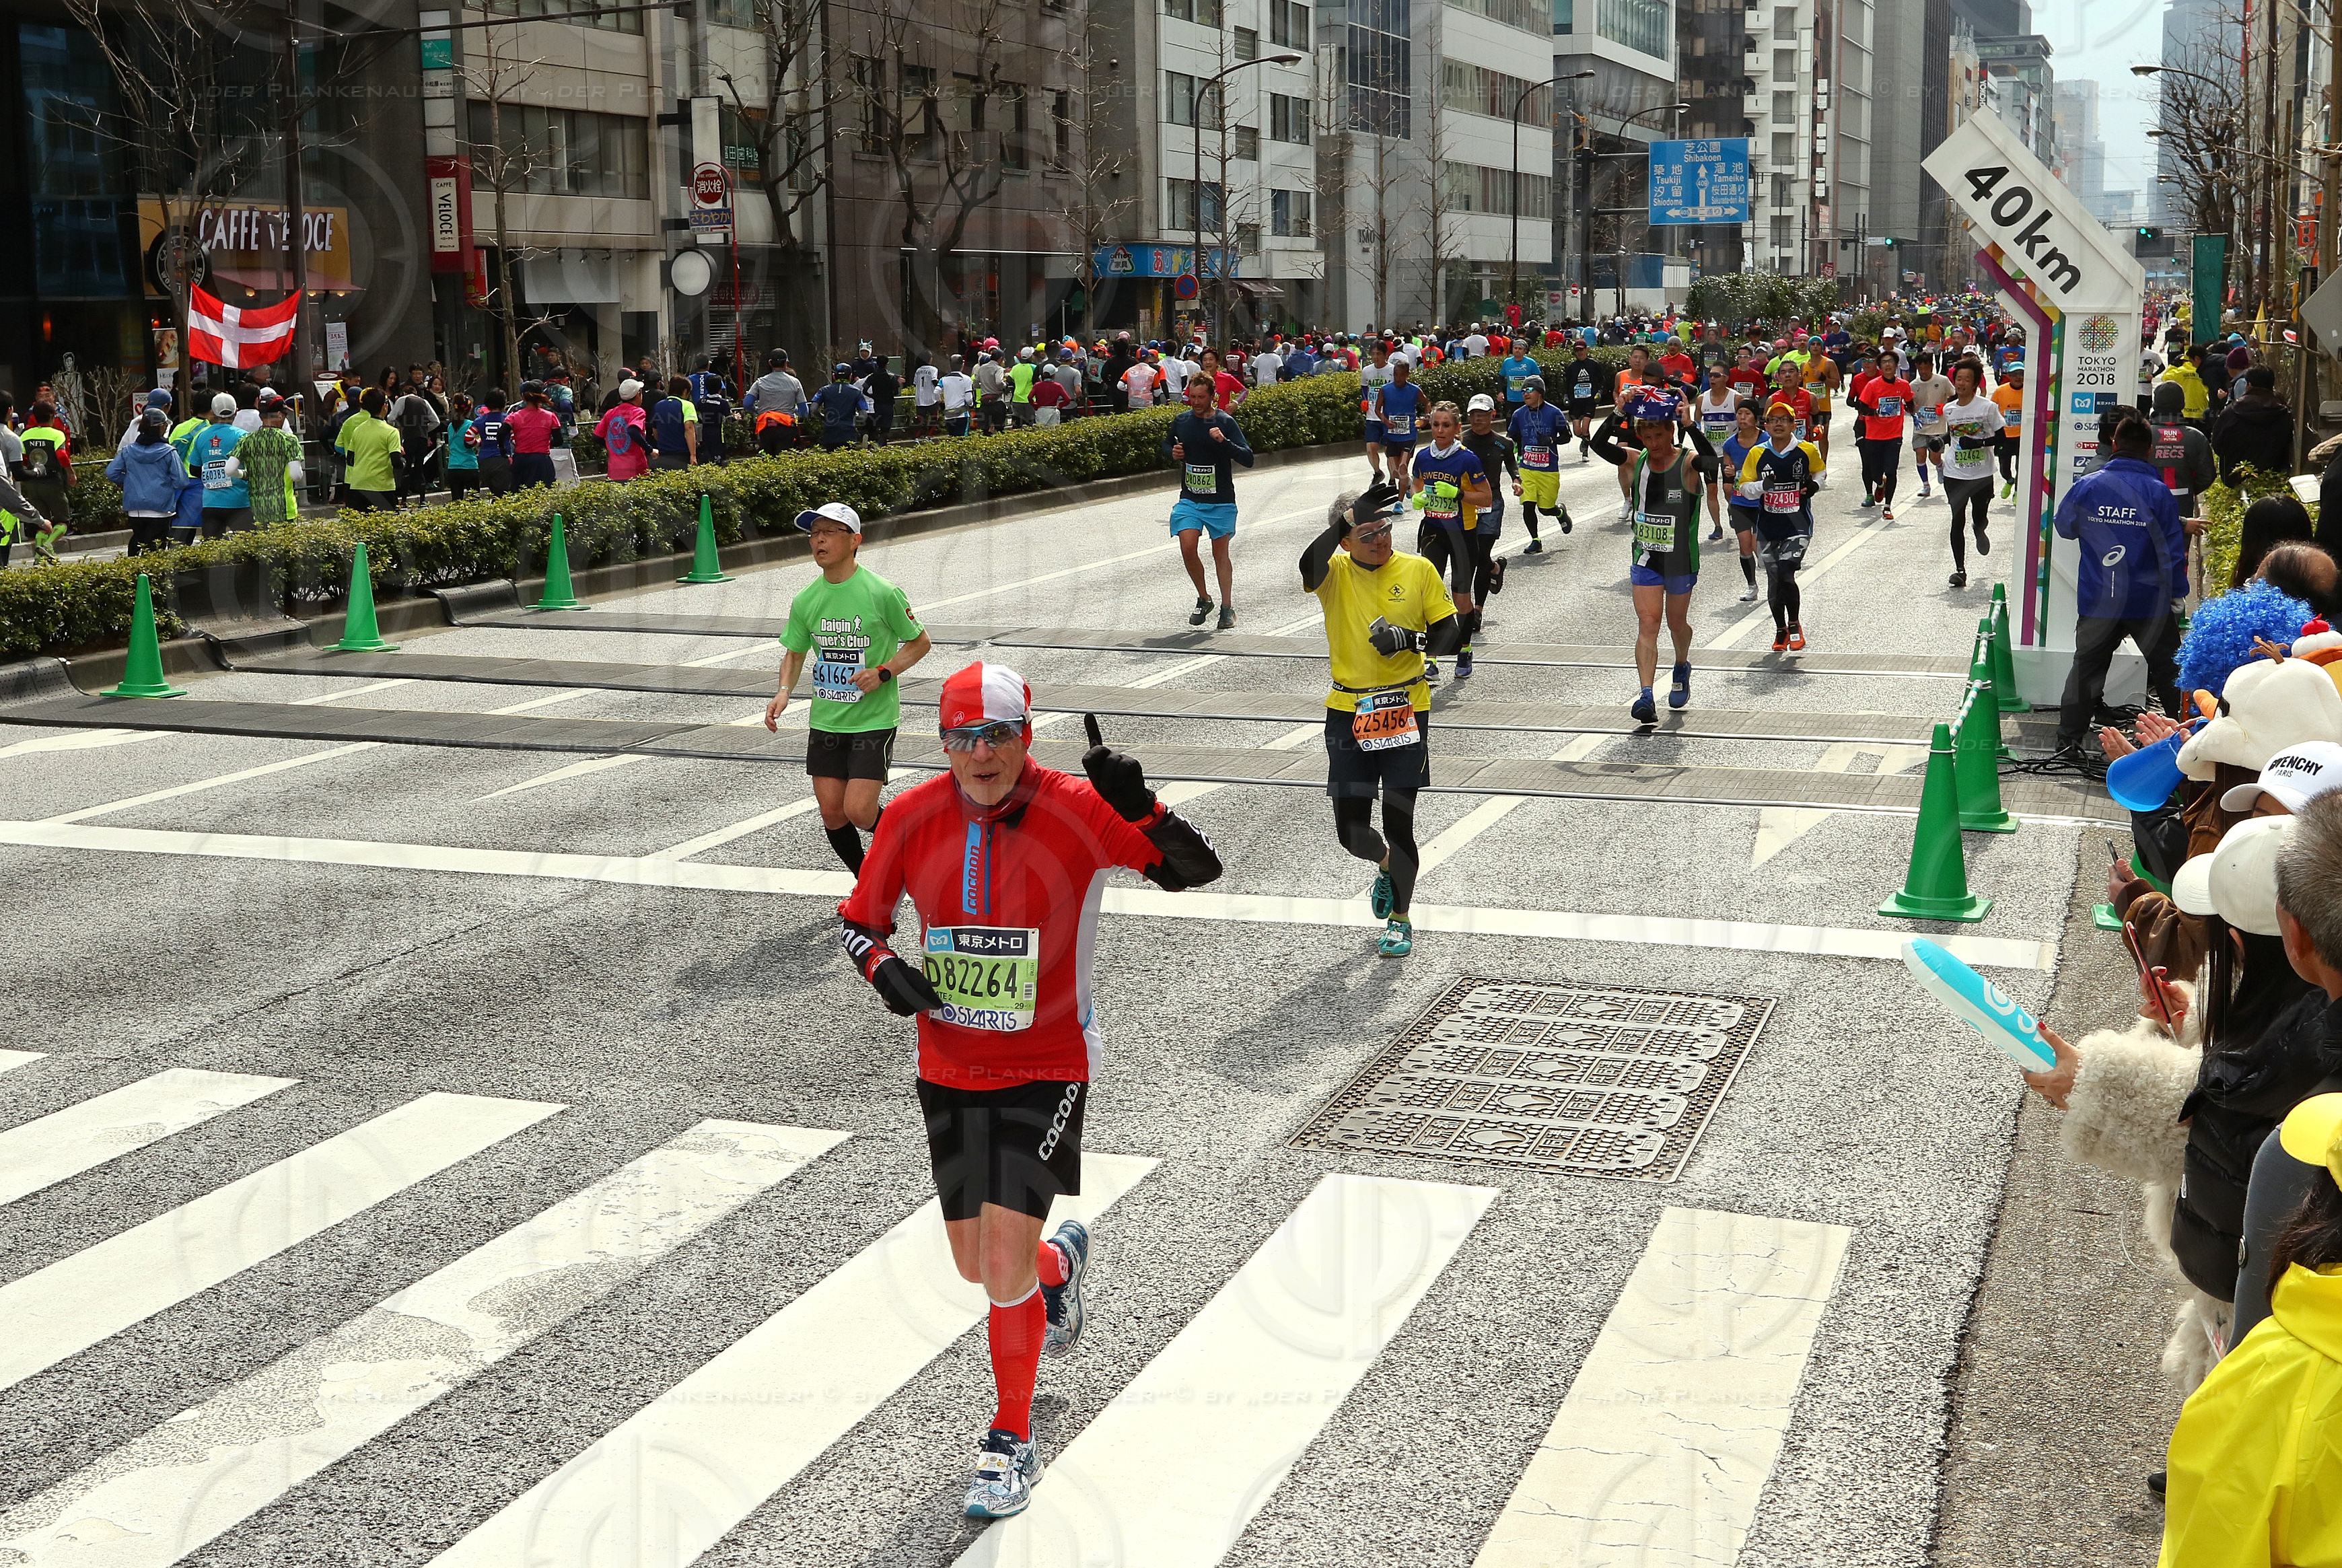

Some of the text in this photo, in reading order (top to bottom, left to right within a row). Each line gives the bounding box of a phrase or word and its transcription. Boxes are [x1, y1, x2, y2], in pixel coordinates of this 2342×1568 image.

[1684, 141, 1721, 153] 芝公園
[1684, 154, 1722, 163] Shibakoen
[1654, 164, 1682, 175] 築地
[1714, 162, 1744, 174] 溜池
[1656, 176, 1681, 185] Tsukiji
[1713, 174, 1744, 182] Tameike
[697, 180, 722, 193] 消火栓
[1654, 186, 1682, 197] 汐留
[1711, 184, 1745, 196] 桜田通り
[438, 193, 454, 235] VELOCE
[690, 212, 730, 225] さわやか
[1964, 165, 2082, 295] 40km
[2078, 356, 2117, 365] TOKYO
[921, 376, 924, 387] 1
[2077, 373, 2115, 386] 2018
[1955, 450, 1980, 461] E32462
[2156, 450, 2185, 458] RECS
[202, 469, 225, 481] E60389
[1185, 473, 1211, 485] D80862
[1423, 471, 1457, 483] SWEDEN
[1765, 493, 1794, 504] E72430
[2098, 505, 2137, 518] STAFF
[820, 618, 851, 633] Daigin
[847, 634, 871, 648] Club
[824, 651, 857, 660] 東京メトロ
[1354, 709, 1405, 734] C25456
[2274, 769, 2293, 778] PARIS
[958, 933, 1023, 950] 東京メトロ
[925, 956, 1018, 999] D82264
